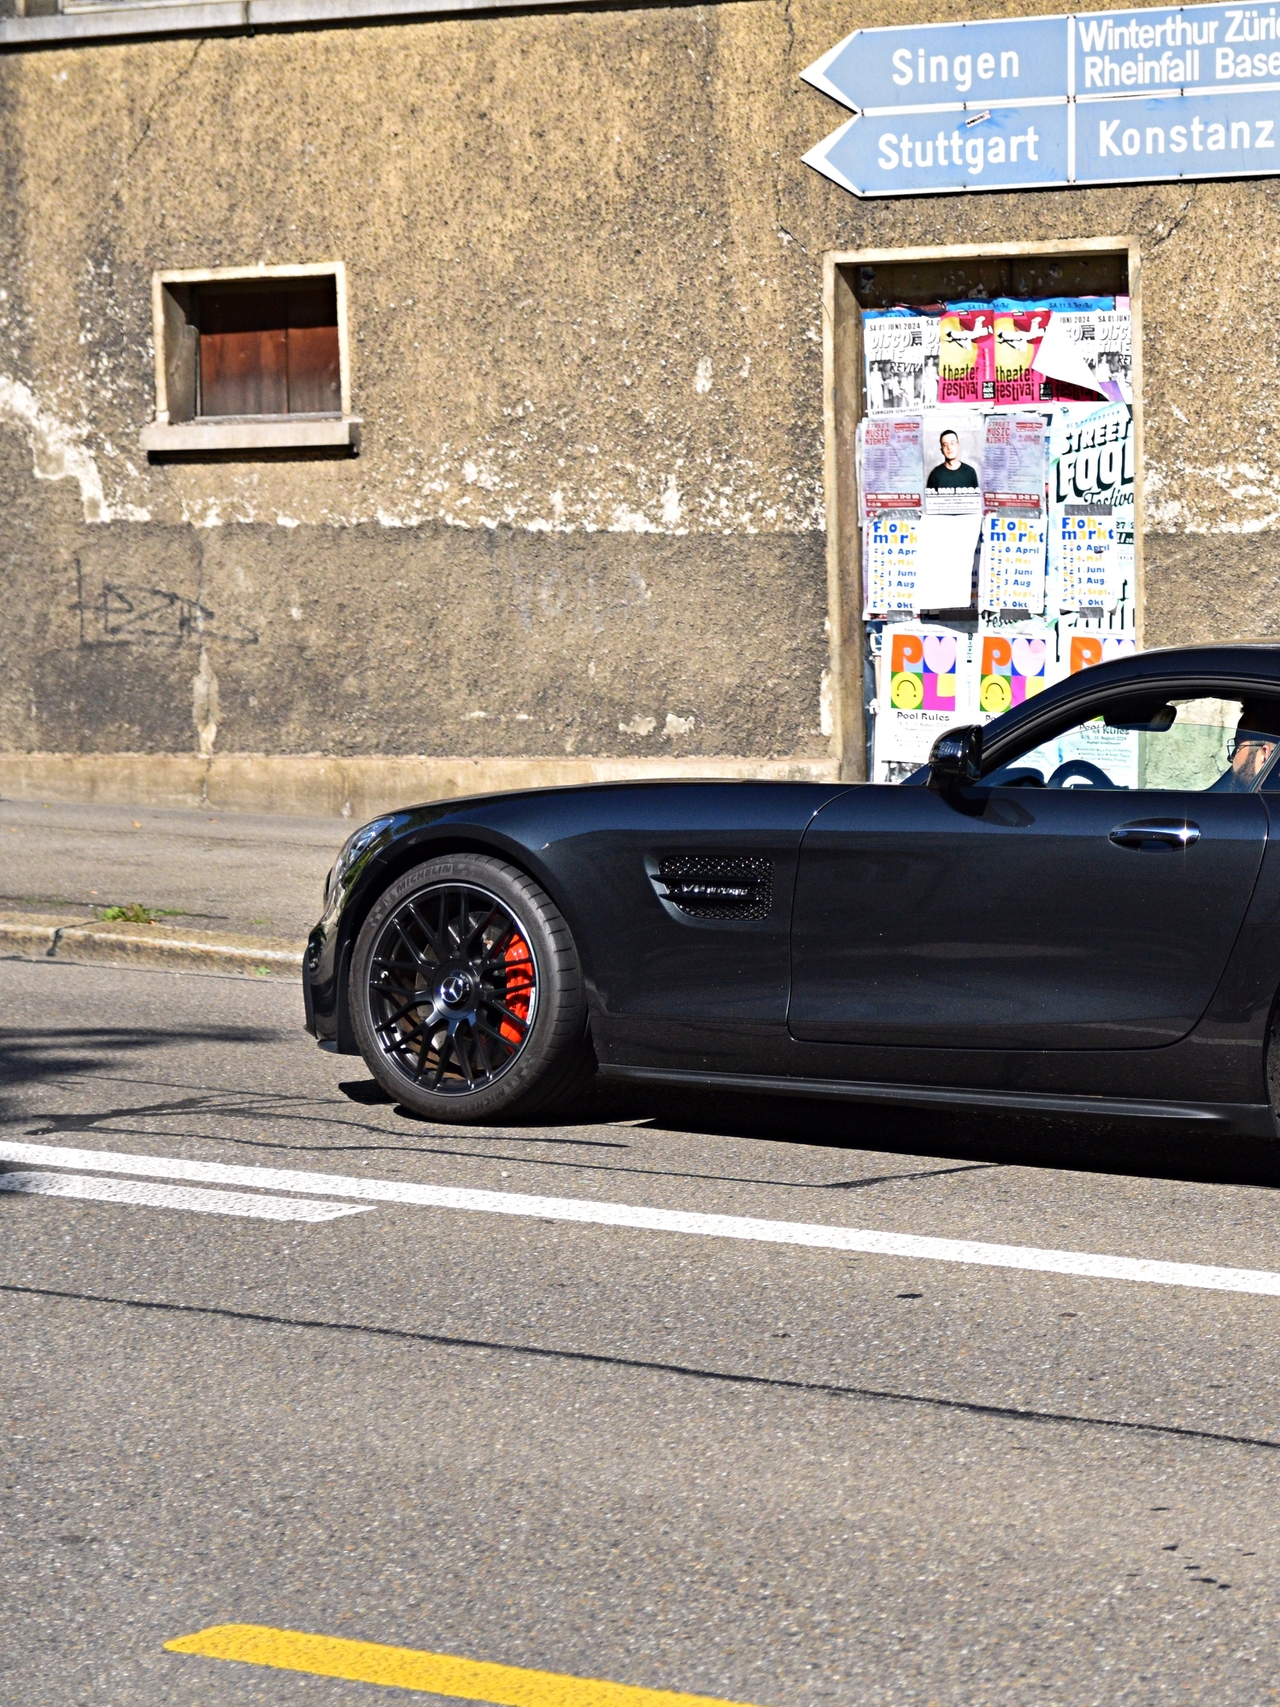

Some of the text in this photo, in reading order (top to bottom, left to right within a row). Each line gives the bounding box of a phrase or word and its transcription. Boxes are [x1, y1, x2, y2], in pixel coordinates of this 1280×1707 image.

[1079, 12, 1218, 52] Winterthur
[892, 47, 1020, 92] Singen
[1084, 50, 1199, 89] Rheinfall
[1099, 118, 1276, 157] Konstanz
[878, 126, 1040, 175] Stuttgart
[903, 322, 921, 330] 2024
[942, 364, 979, 382] theater
[995, 365, 1035, 383] theater
[942, 380, 979, 401] festival
[996, 382, 1035, 401] festival
[866, 429, 890, 437] MUSIC
[986, 428, 1010, 437] MUSIC
[1061, 417, 1134, 455] STREET
[873, 520, 916, 533] Floh-
[991, 517, 1034, 531] Floh-
[1062, 516, 1103, 530] Floh-
[990, 531, 1044, 543] markt
[1062, 528, 1114, 541] markt
[1015, 546, 1040, 555] April
[1086, 544, 1110, 553] April
[1014, 568, 1033, 576] Juni
[896, 711, 950, 722] Pool Rules
[396, 863, 453, 894] MICHELIN
